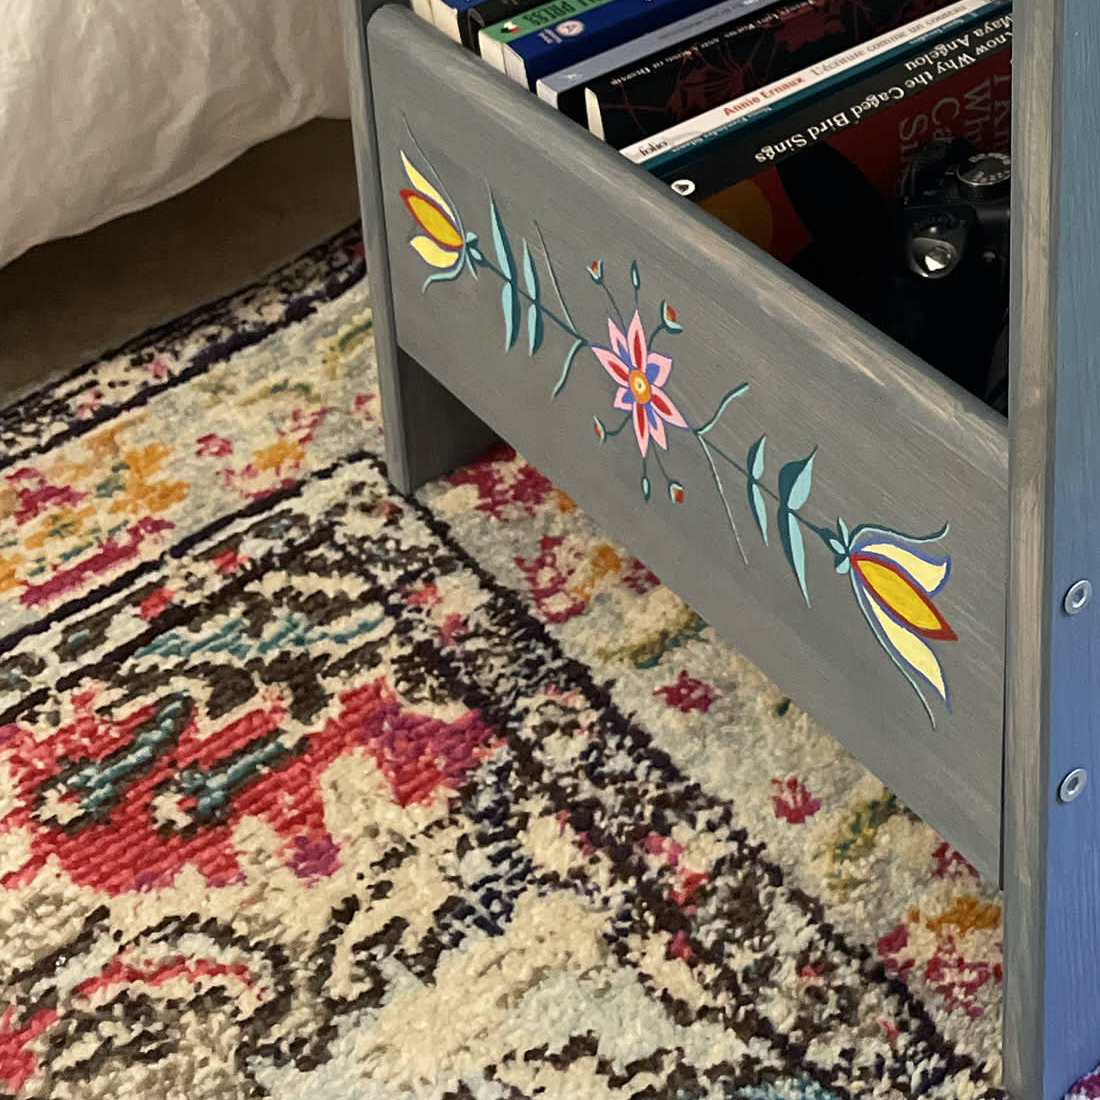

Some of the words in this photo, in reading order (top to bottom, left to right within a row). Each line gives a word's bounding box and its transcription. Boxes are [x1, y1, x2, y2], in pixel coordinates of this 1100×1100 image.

[522, 1, 577, 26] PRESS
[972, 13, 1014, 38] Maya
[904, 35, 971, 71] Angelou
[936, 52, 977, 75] Why
[723, 95, 761, 117] Annie
[761, 76, 805, 99] Ernaux
[866, 30, 907, 55] comme
[908, 23, 925, 34] un
[904, 71, 934, 89] the
[850, 86, 905, 119] Caged
[807, 112, 850, 141] Bird
[638, 139, 669, 157] folio
[754, 133, 808, 163] Sings
